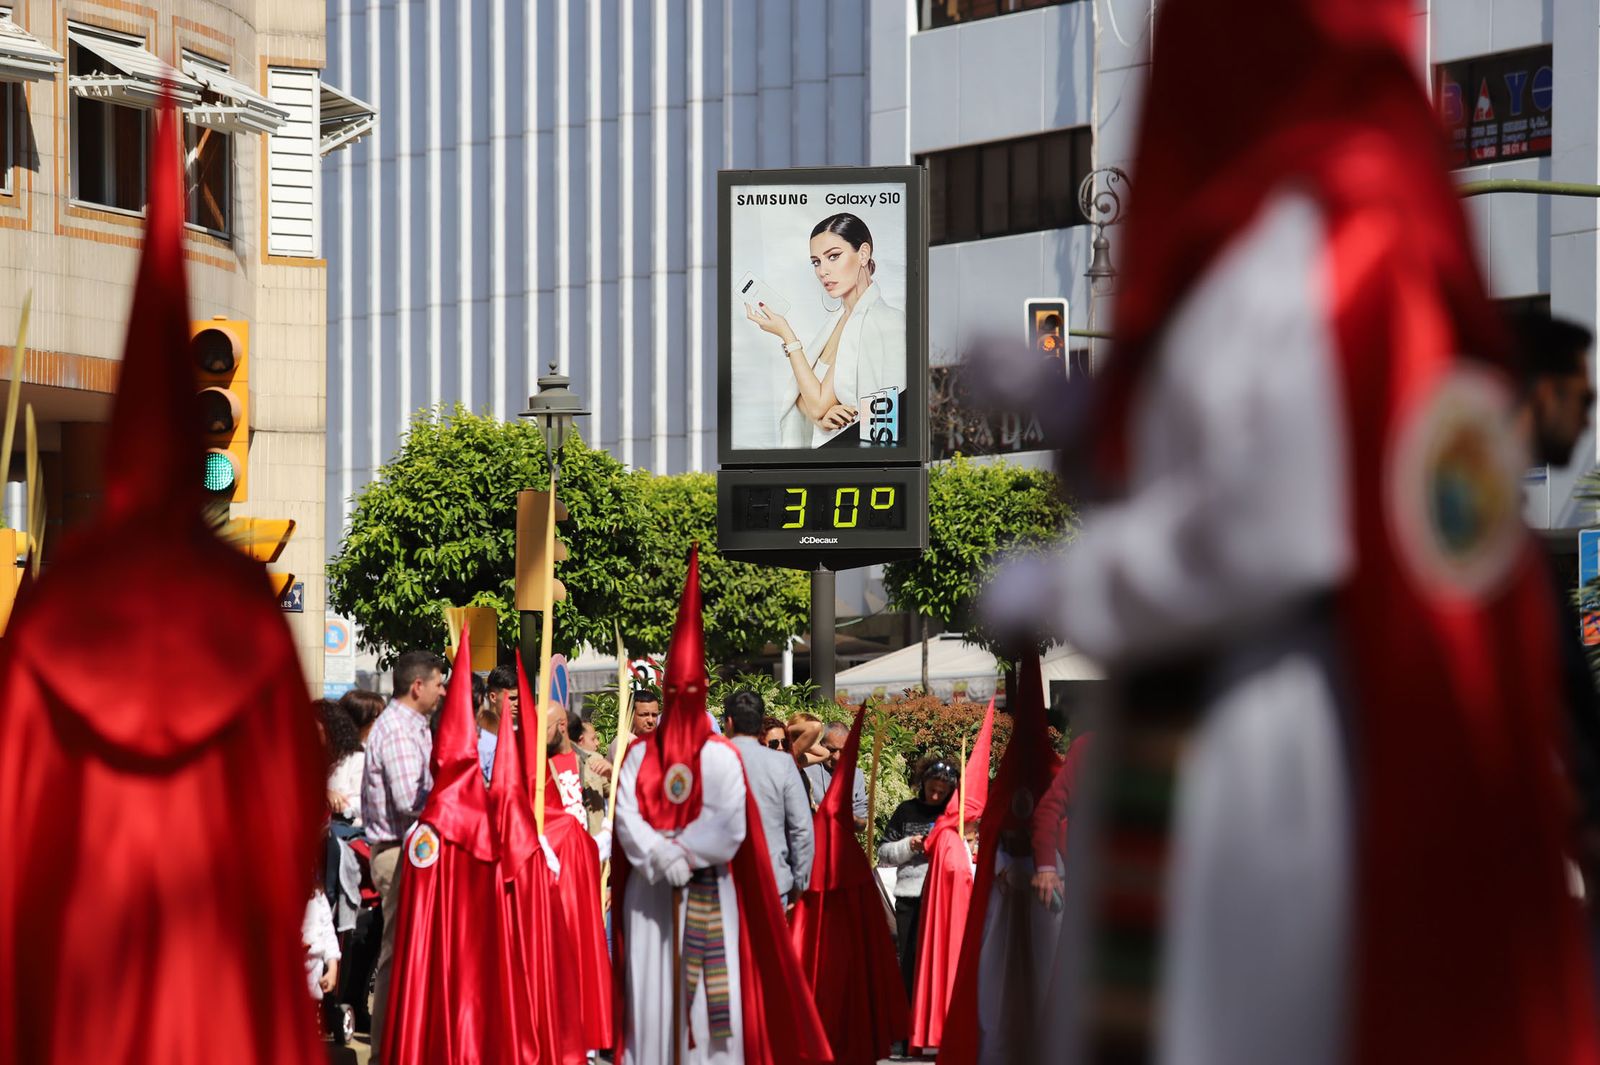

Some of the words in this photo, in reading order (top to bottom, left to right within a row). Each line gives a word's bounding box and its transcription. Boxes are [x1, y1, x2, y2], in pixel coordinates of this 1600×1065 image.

[737, 194, 808, 206] SAMSUNG
[825, 193, 876, 207] Galaxy
[879, 192, 901, 204] S10
[870, 397, 893, 446] S10
[799, 536, 838, 544] JCDecaux
